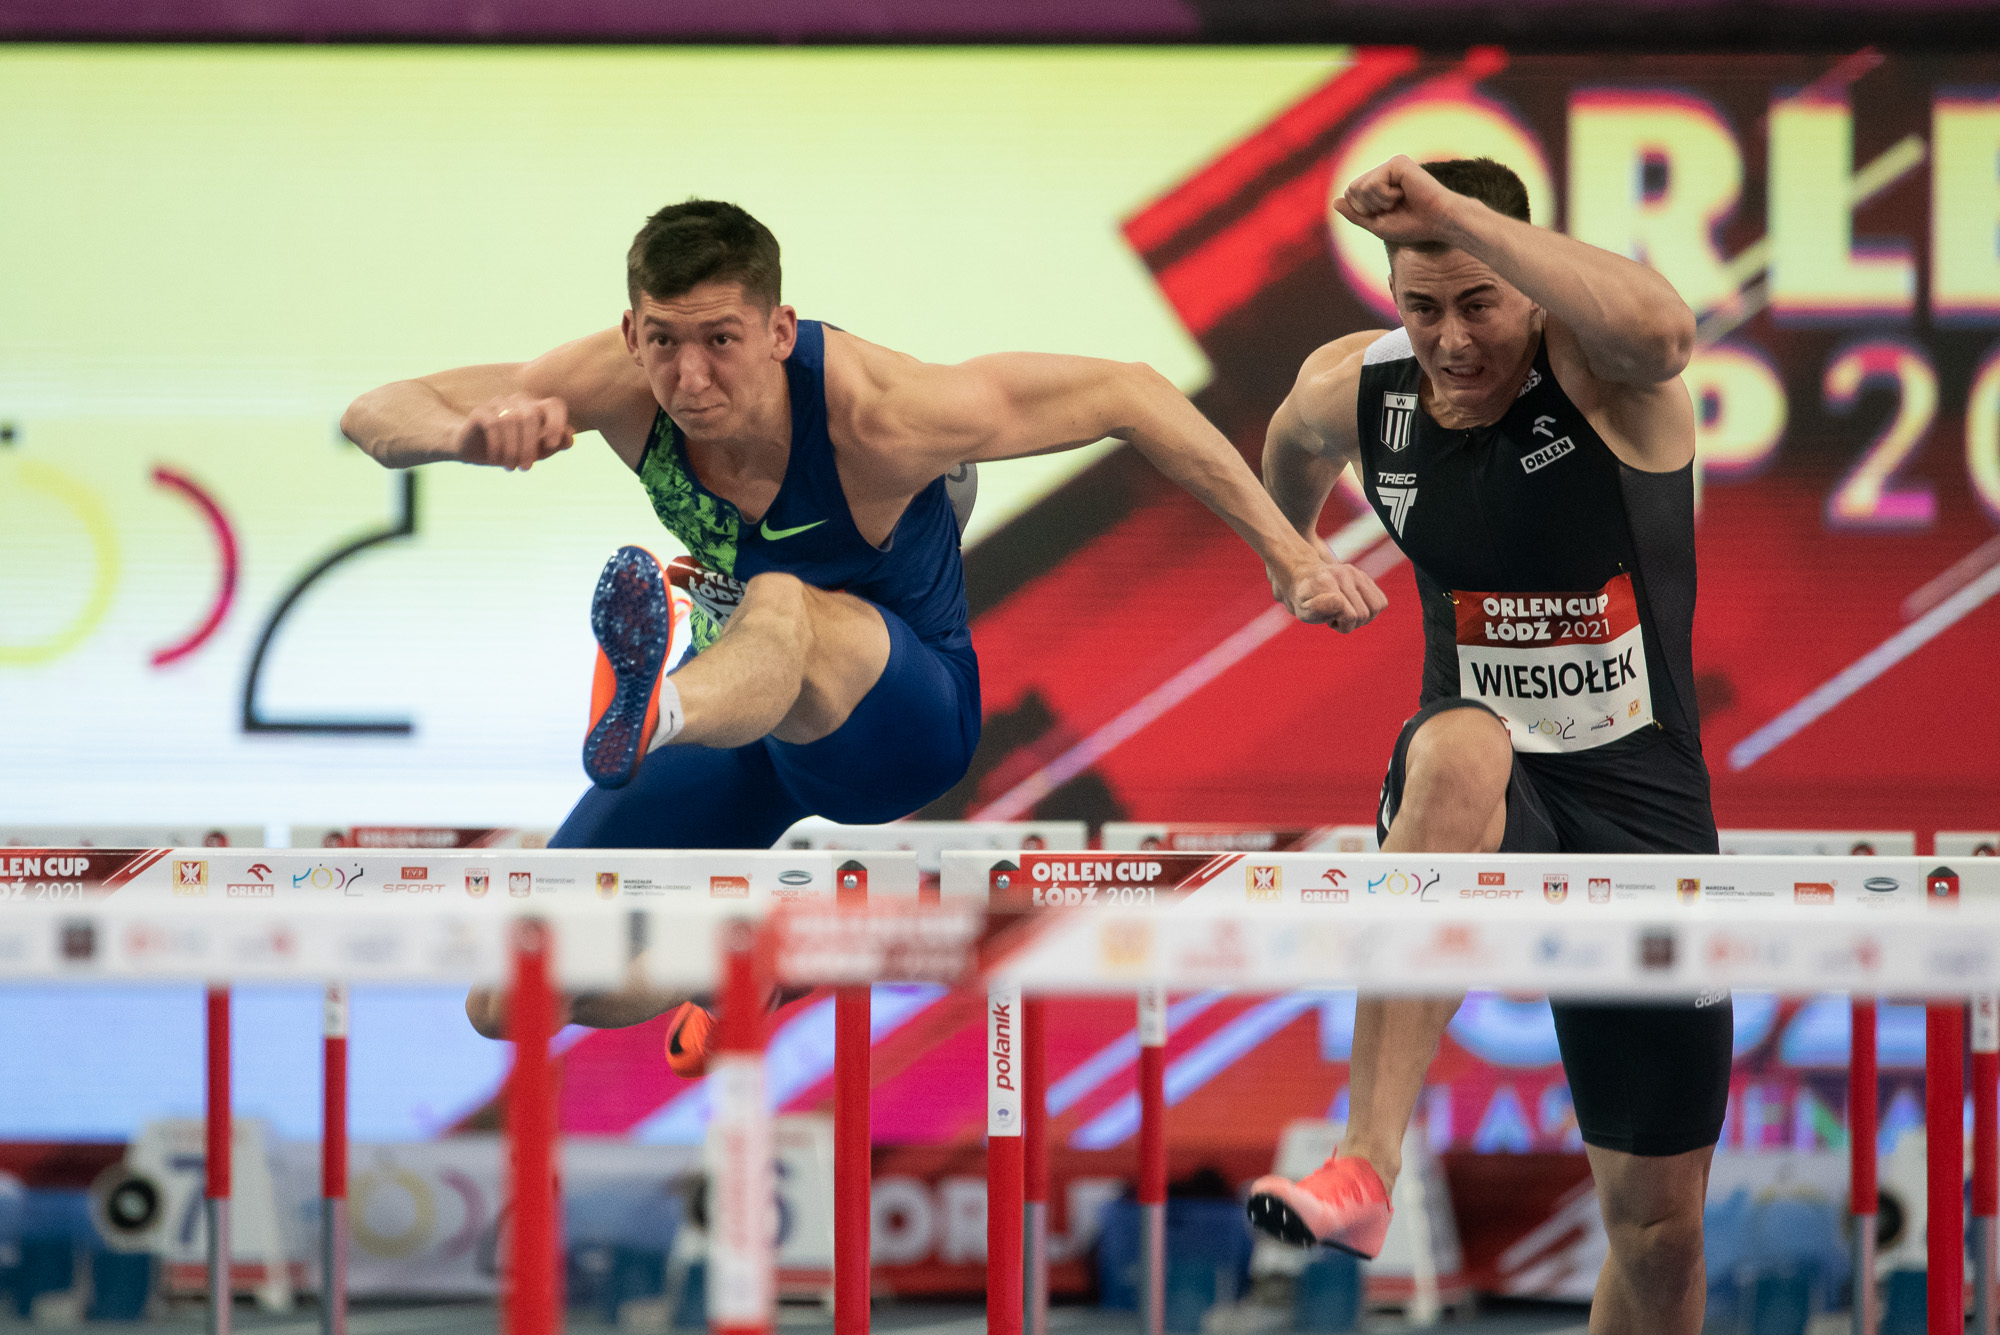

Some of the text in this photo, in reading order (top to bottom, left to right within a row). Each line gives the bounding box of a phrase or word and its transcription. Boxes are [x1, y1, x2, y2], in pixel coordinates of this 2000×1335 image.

[1525, 439, 1571, 470] ORLEN
[1378, 471, 1417, 485] TREC
[1483, 593, 1609, 618] ORLEN CUP
[1485, 618, 1610, 641] ŁÓDŹ 2021
[1470, 646, 1637, 700] WIESIOŁEK
[44, 857, 90, 877] CUP
[1032, 862, 1162, 882] ORLEN CUP
[34, 882, 83, 901] 2021
[228, 886, 272, 897] ORLEN
[383, 884, 446, 893] SPORT
[1032, 882, 1156, 907] ŁÓDŹ 2021
[1303, 891, 1347, 902] ORLEN
[1459, 890, 1524, 899] SPORT
[991, 1002, 1015, 1092] polanik
